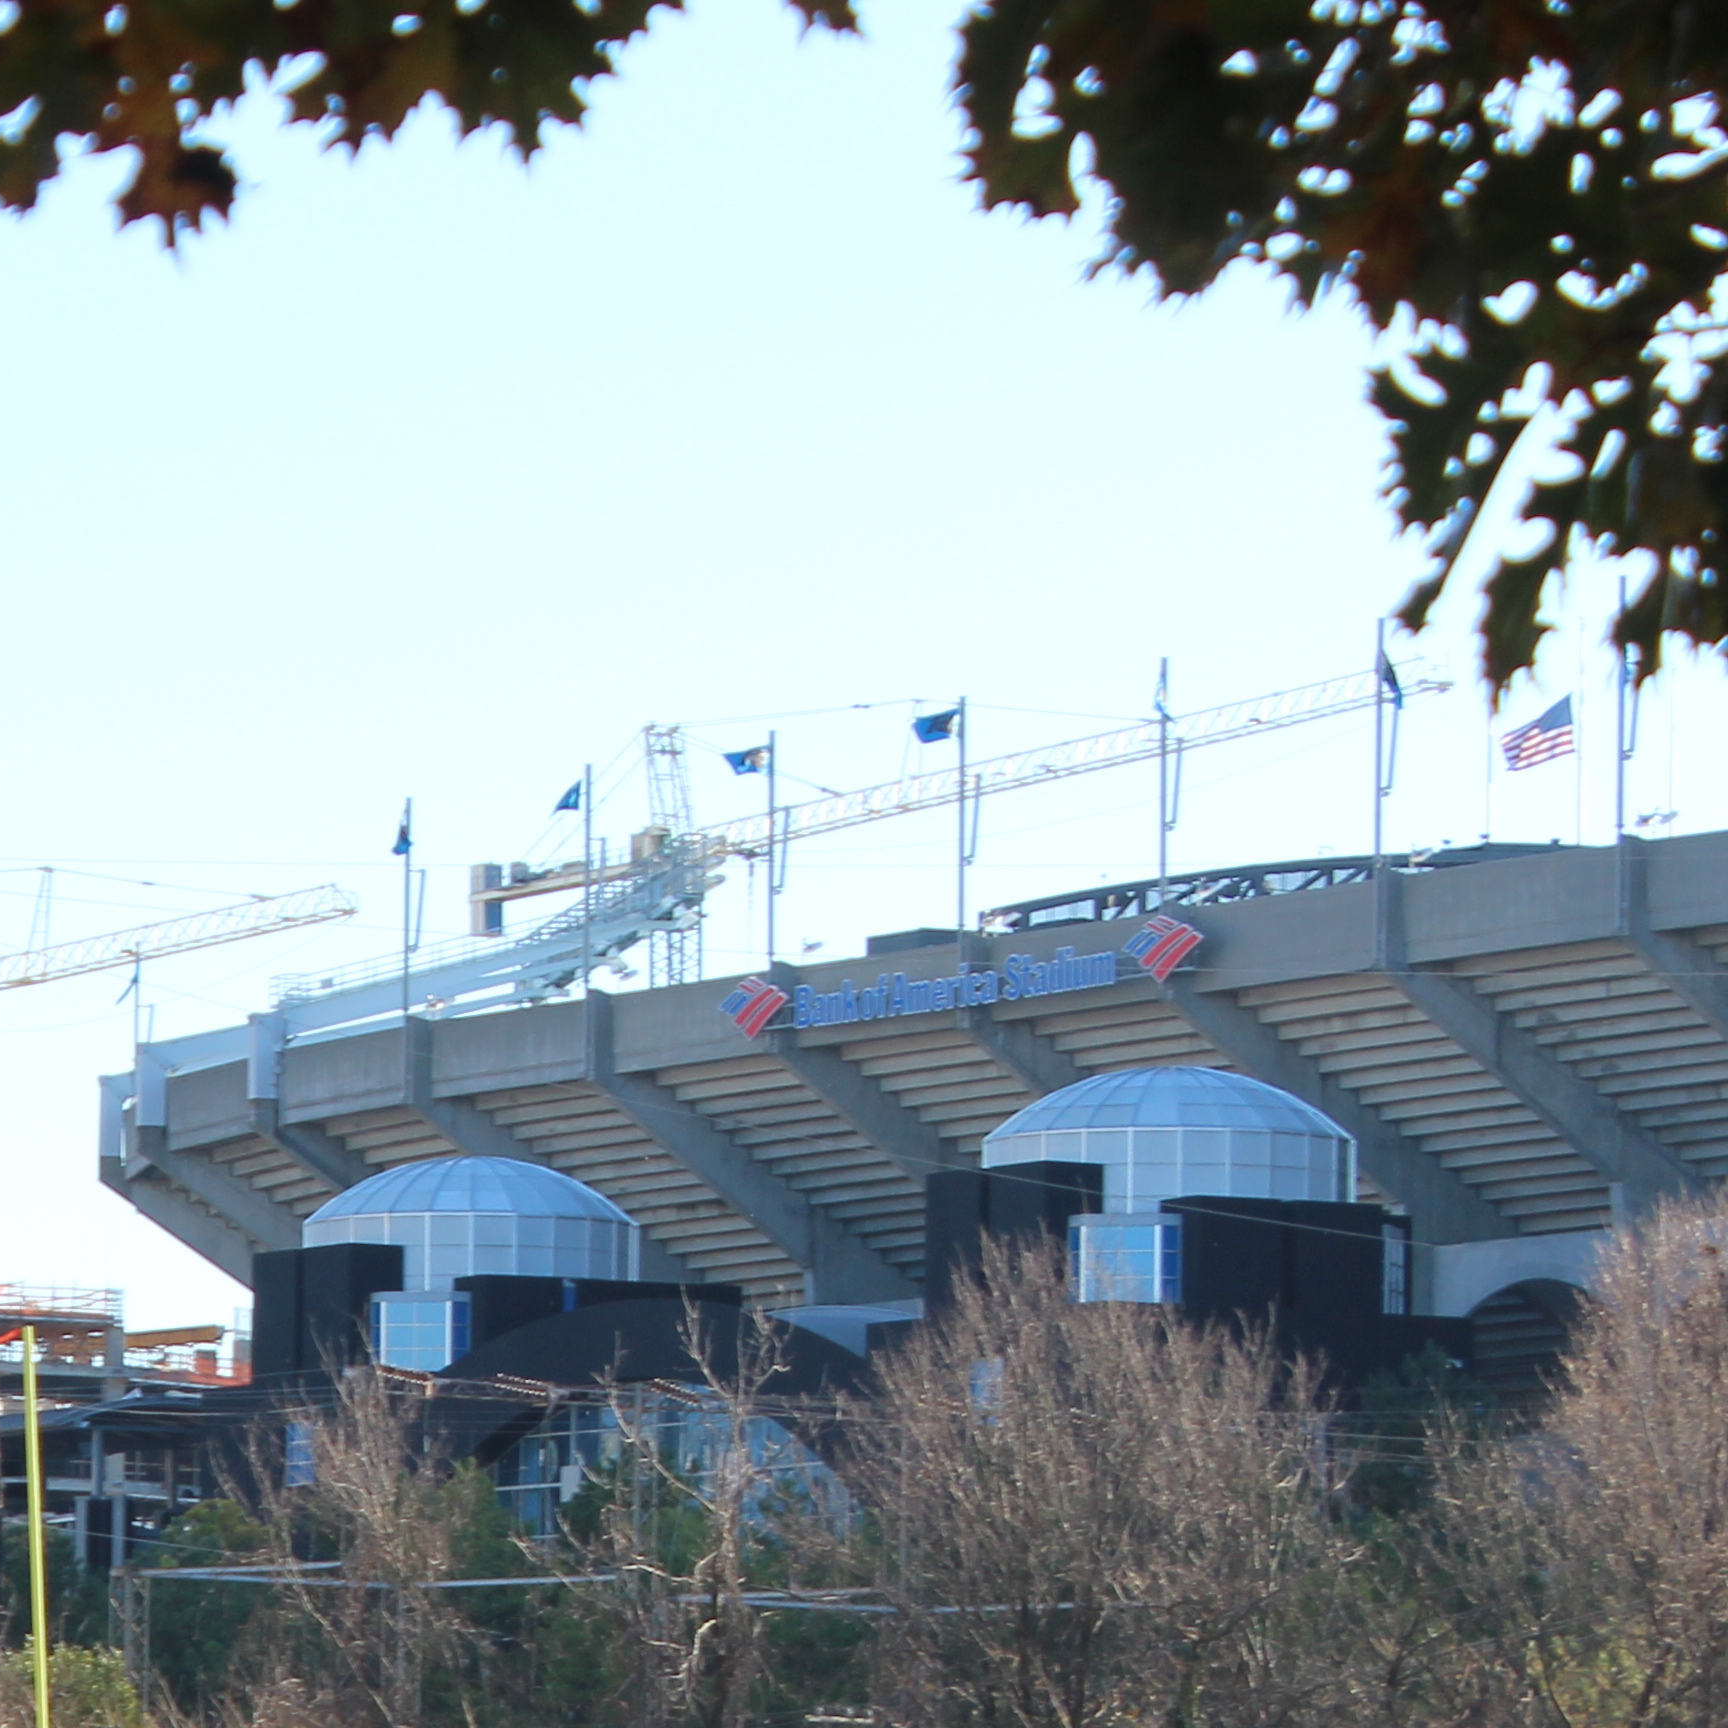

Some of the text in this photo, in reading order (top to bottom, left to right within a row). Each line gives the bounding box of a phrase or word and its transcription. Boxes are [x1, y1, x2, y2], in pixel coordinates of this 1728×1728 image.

[795, 947, 1116, 1028] Bank of America Stadium
